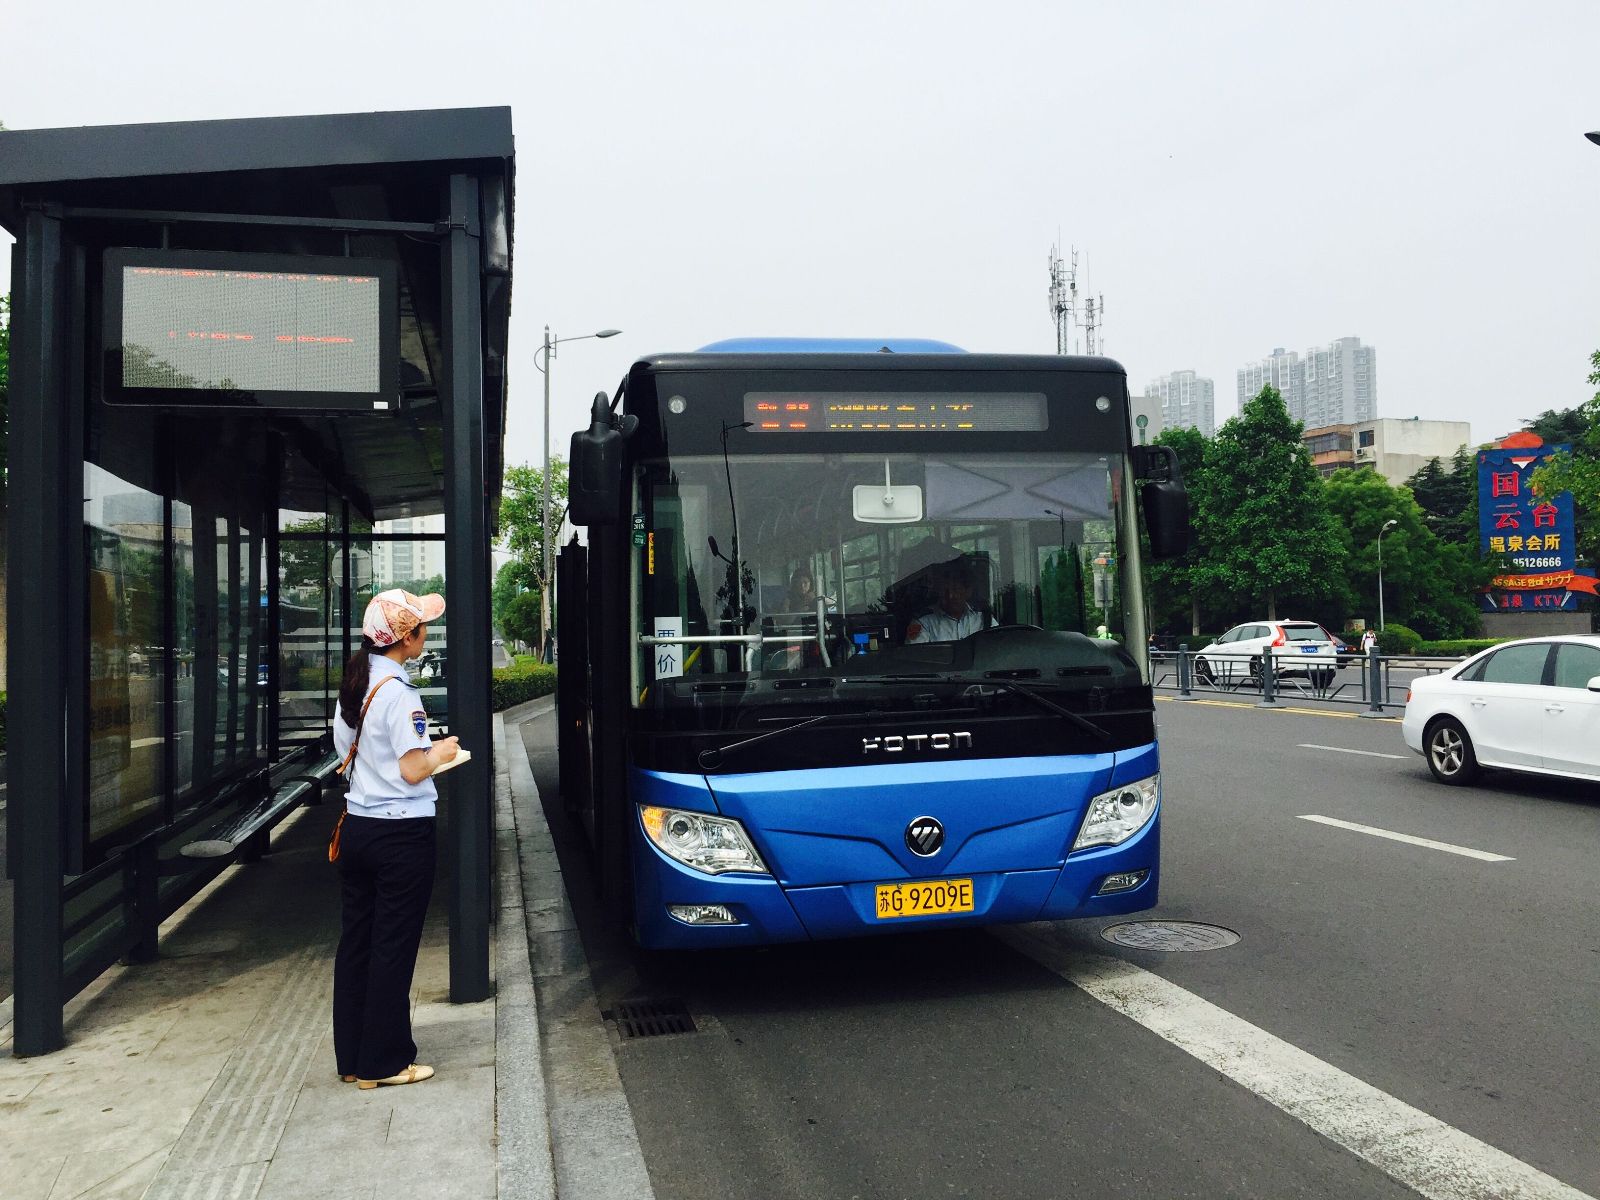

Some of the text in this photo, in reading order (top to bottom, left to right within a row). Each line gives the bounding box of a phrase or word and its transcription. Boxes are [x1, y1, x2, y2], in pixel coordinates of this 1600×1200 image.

[1490, 533, 1561, 553] 温泉会所
[1534, 594, 1563, 608] KTV
[862, 731, 973, 754] FOTON
